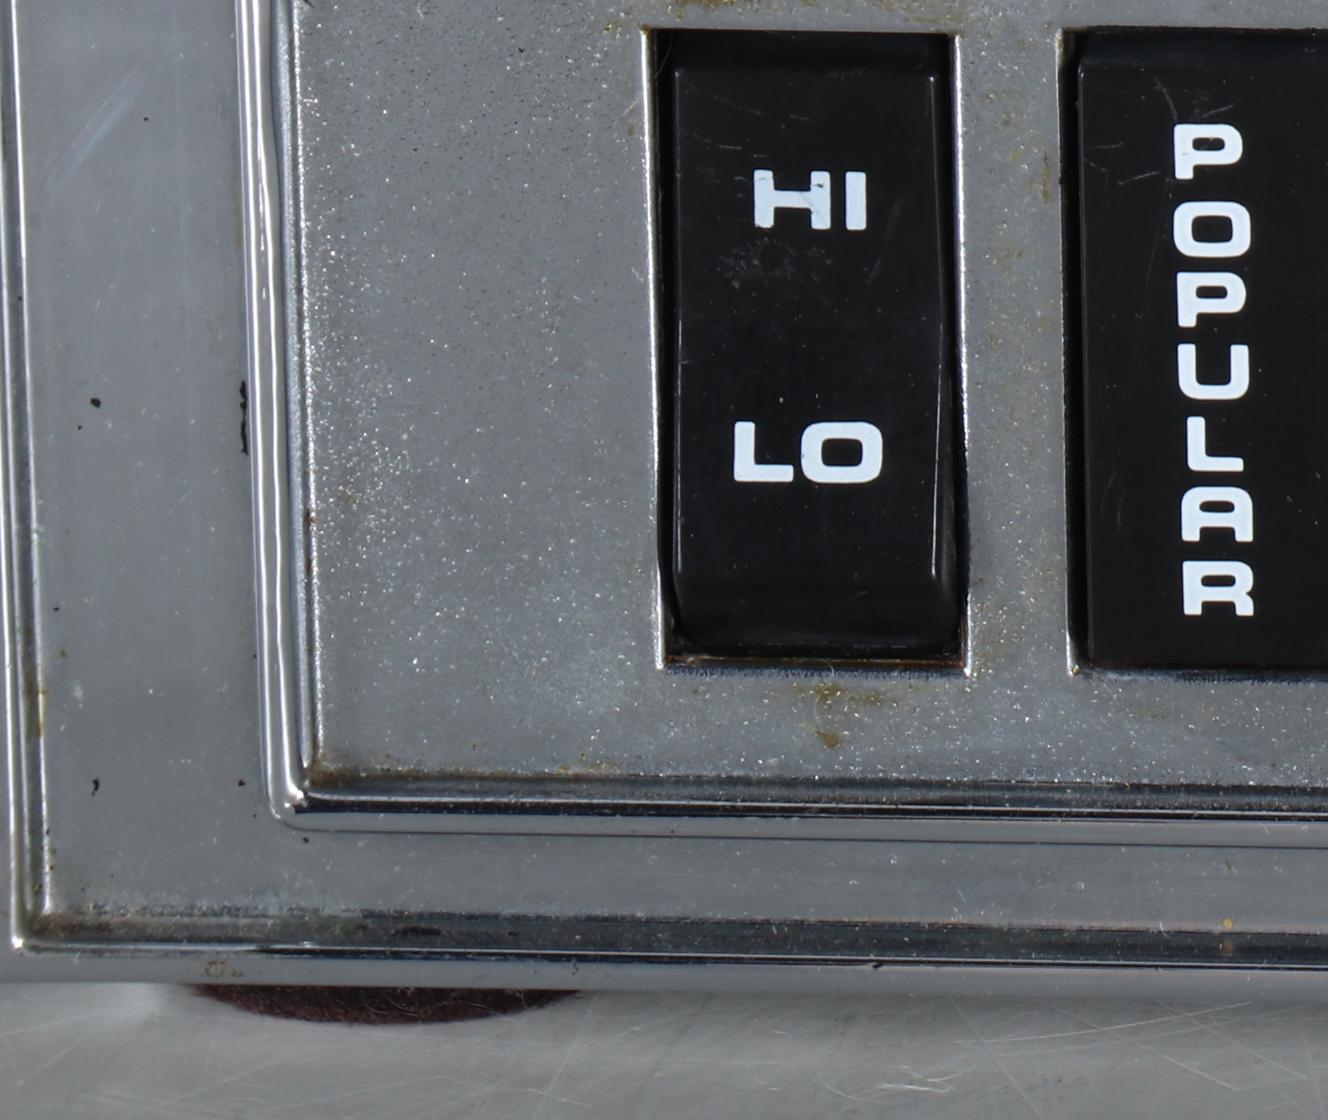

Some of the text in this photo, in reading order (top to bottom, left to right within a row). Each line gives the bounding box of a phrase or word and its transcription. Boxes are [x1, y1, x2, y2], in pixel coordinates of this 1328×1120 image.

[754, 169, 867, 231] HI
[1173, 123, 1254, 617] POPULAR
[733, 421, 883, 484] LO
